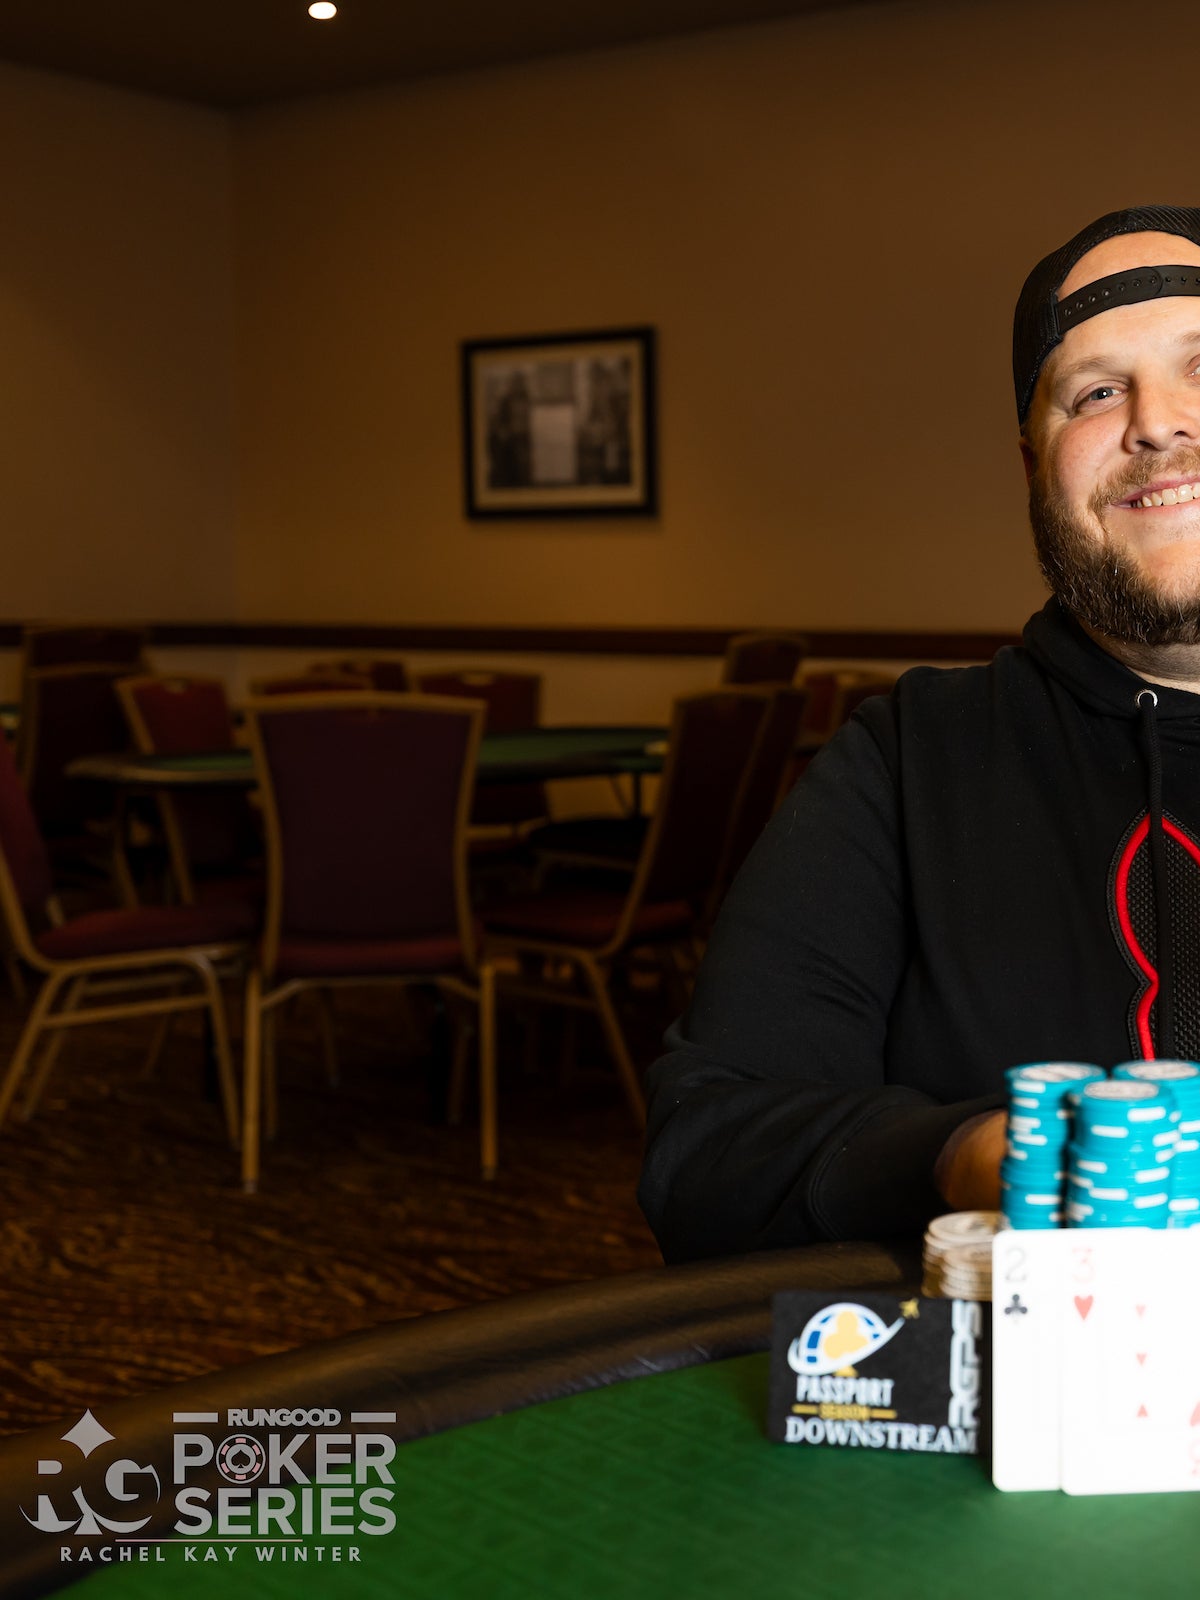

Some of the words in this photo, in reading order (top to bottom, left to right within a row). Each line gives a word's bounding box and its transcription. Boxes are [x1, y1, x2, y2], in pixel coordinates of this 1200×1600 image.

[1004, 1246, 1029, 1283] 2
[1071, 1246, 1096, 1284] 3
[796, 1375, 895, 1406] PASSPORT
[784, 1416, 977, 1455] DOWNSTREAM
